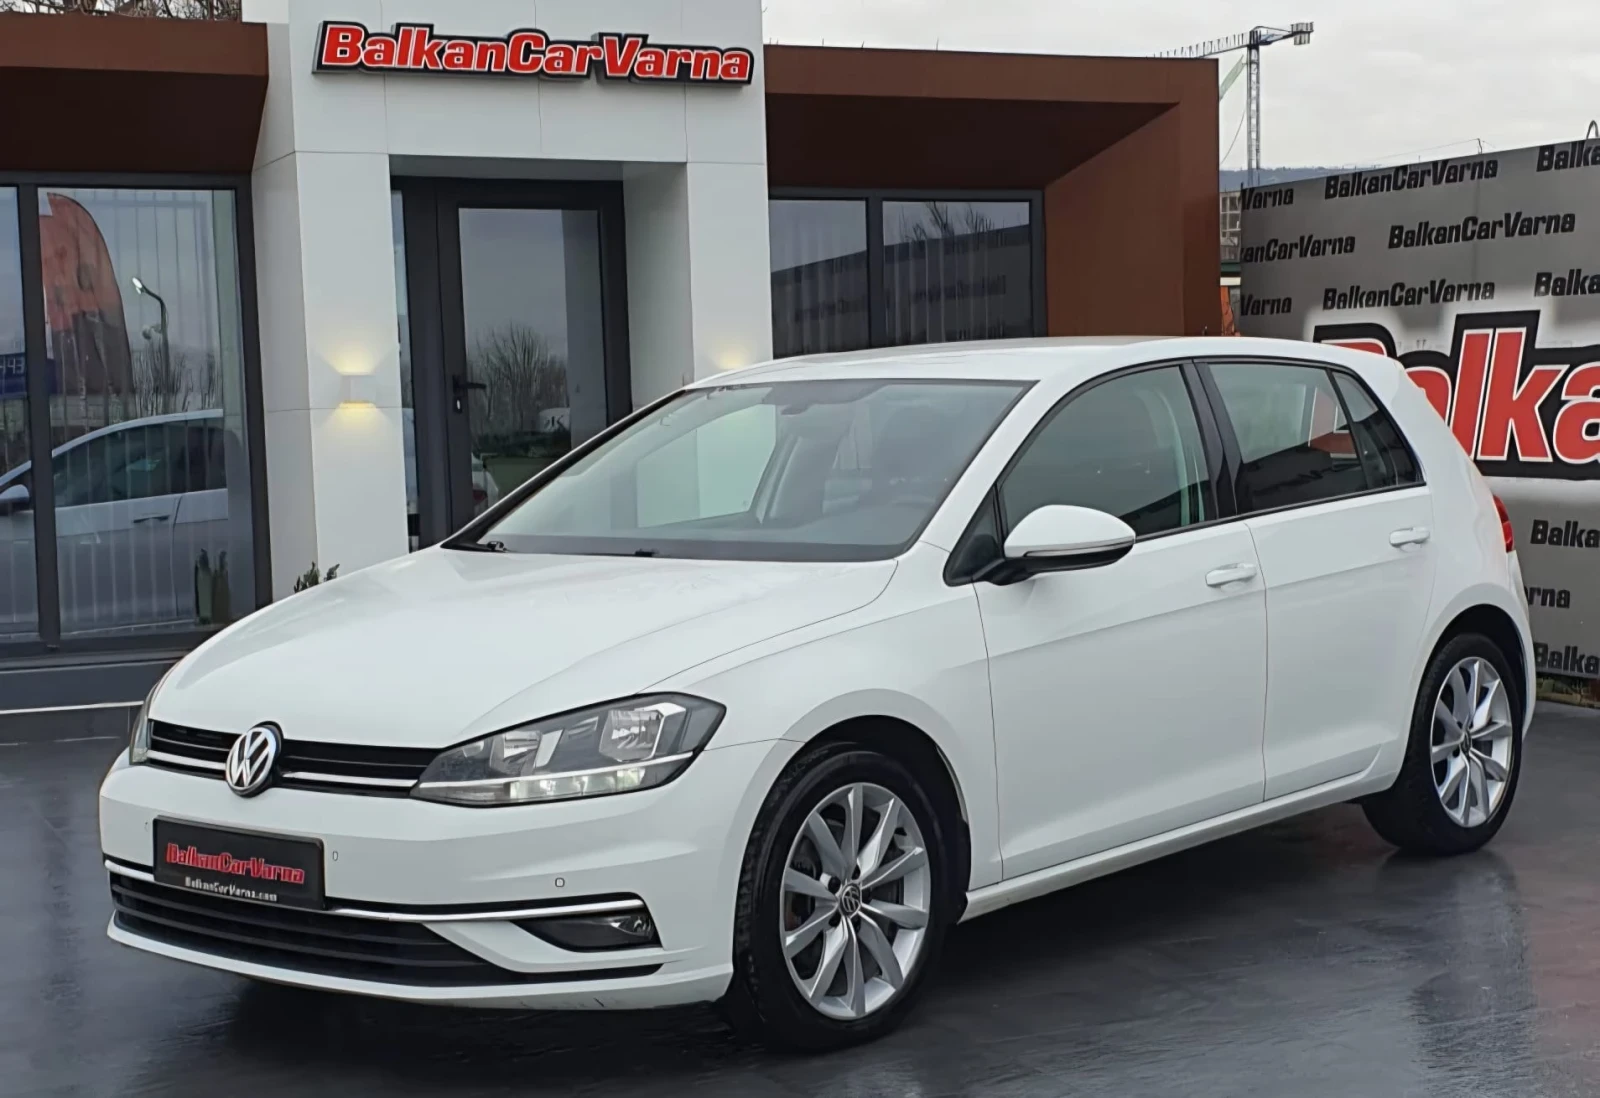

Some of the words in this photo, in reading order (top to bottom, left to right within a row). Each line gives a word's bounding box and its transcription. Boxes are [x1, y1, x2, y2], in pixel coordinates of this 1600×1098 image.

[319, 22, 752, 81] BalkanCarVarna
[1324, 159, 1498, 199] BalkanCarVarna
[1388, 211, 1576, 249] BalkanCarVarna
[1241, 234, 1356, 263] anCarVarna
[1322, 278, 1495, 310] BalkanCarVarna
[1534, 268, 1600, 297] Balka
[1530, 519, 1600, 548] Balka
[1524, 585, 1571, 609] rna
[166, 842, 305, 884] BalkanCarVarna
[185, 876, 278, 902] BalkanCarVarna.com
